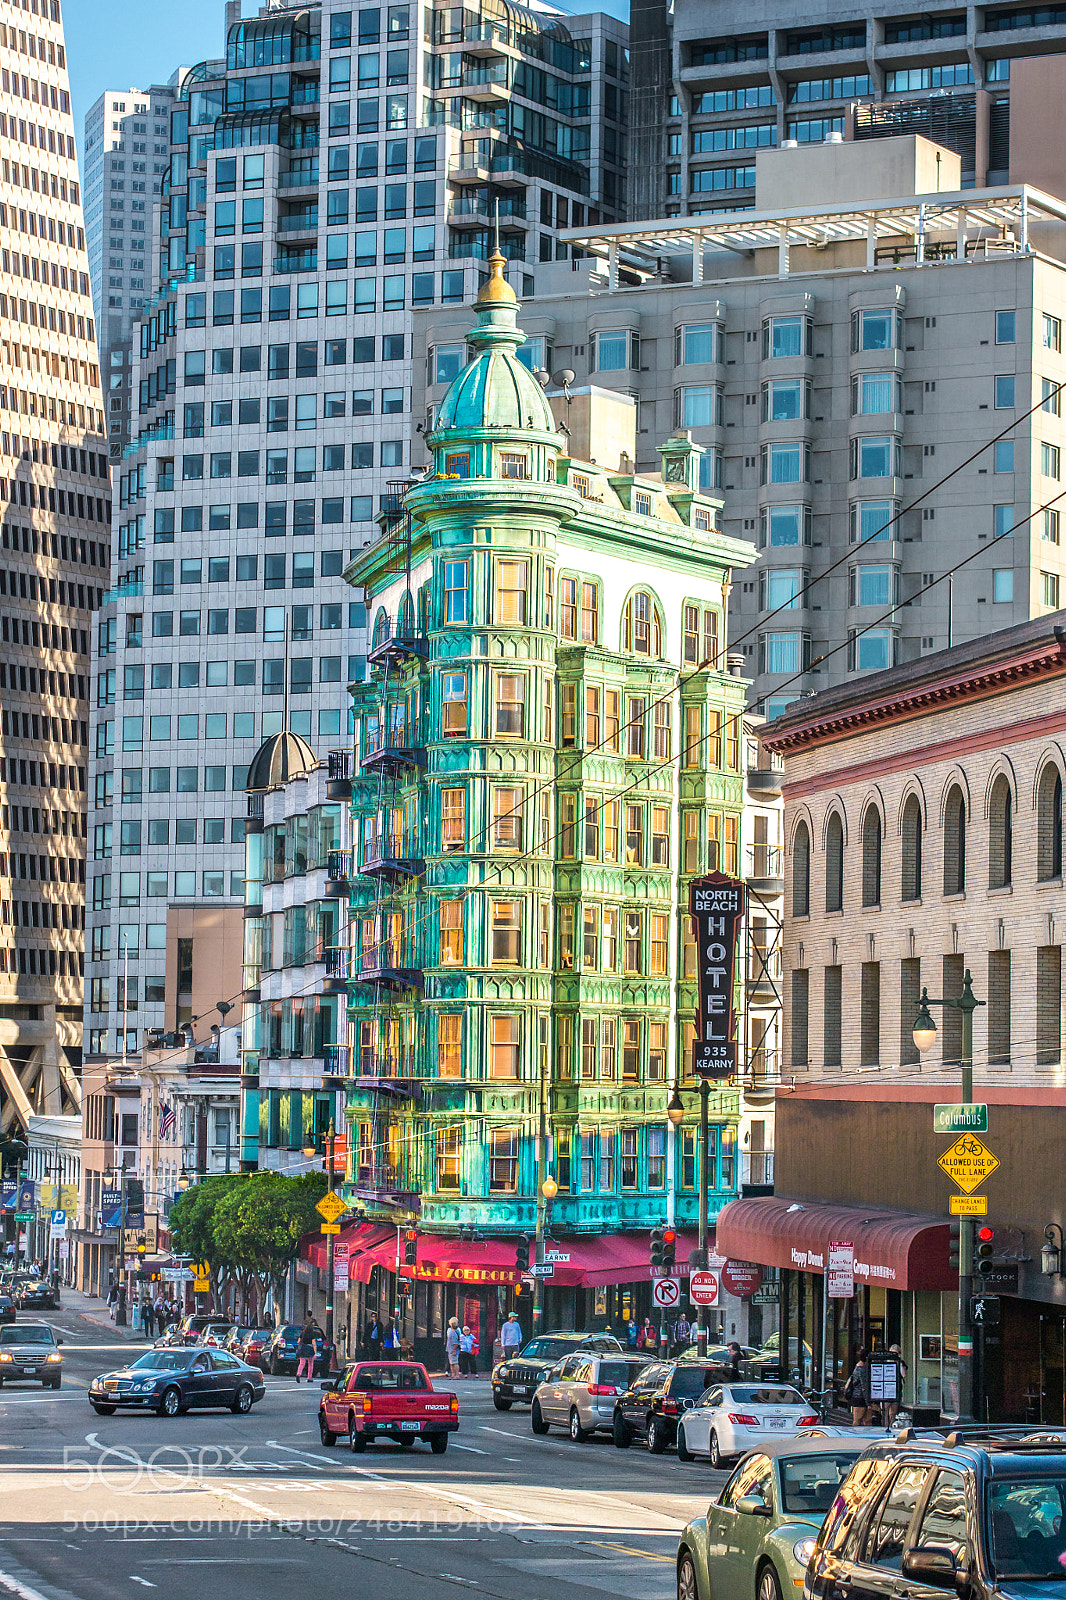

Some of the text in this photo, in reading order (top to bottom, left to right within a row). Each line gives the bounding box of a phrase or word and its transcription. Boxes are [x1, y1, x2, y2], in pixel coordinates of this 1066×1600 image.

[695, 890, 738, 900] NORTH
[695, 901, 738, 911] BEACH
[706, 916, 727, 1041] HOTEL
[704, 1047, 727, 1057] 935
[696, 1059, 734, 1068] KEARNY
[940, 1111, 981, 1125] Columbus
[941, 1158, 971, 1166] ALLOWED
[987, 1159, 995, 1167] OF
[791, 1247, 807, 1268] Happy
[412, 1265, 517, 1281] CAFE ZOETROPE
[853, 1258, 870, 1280] Group
[754, 1284, 779, 1296] ATM
